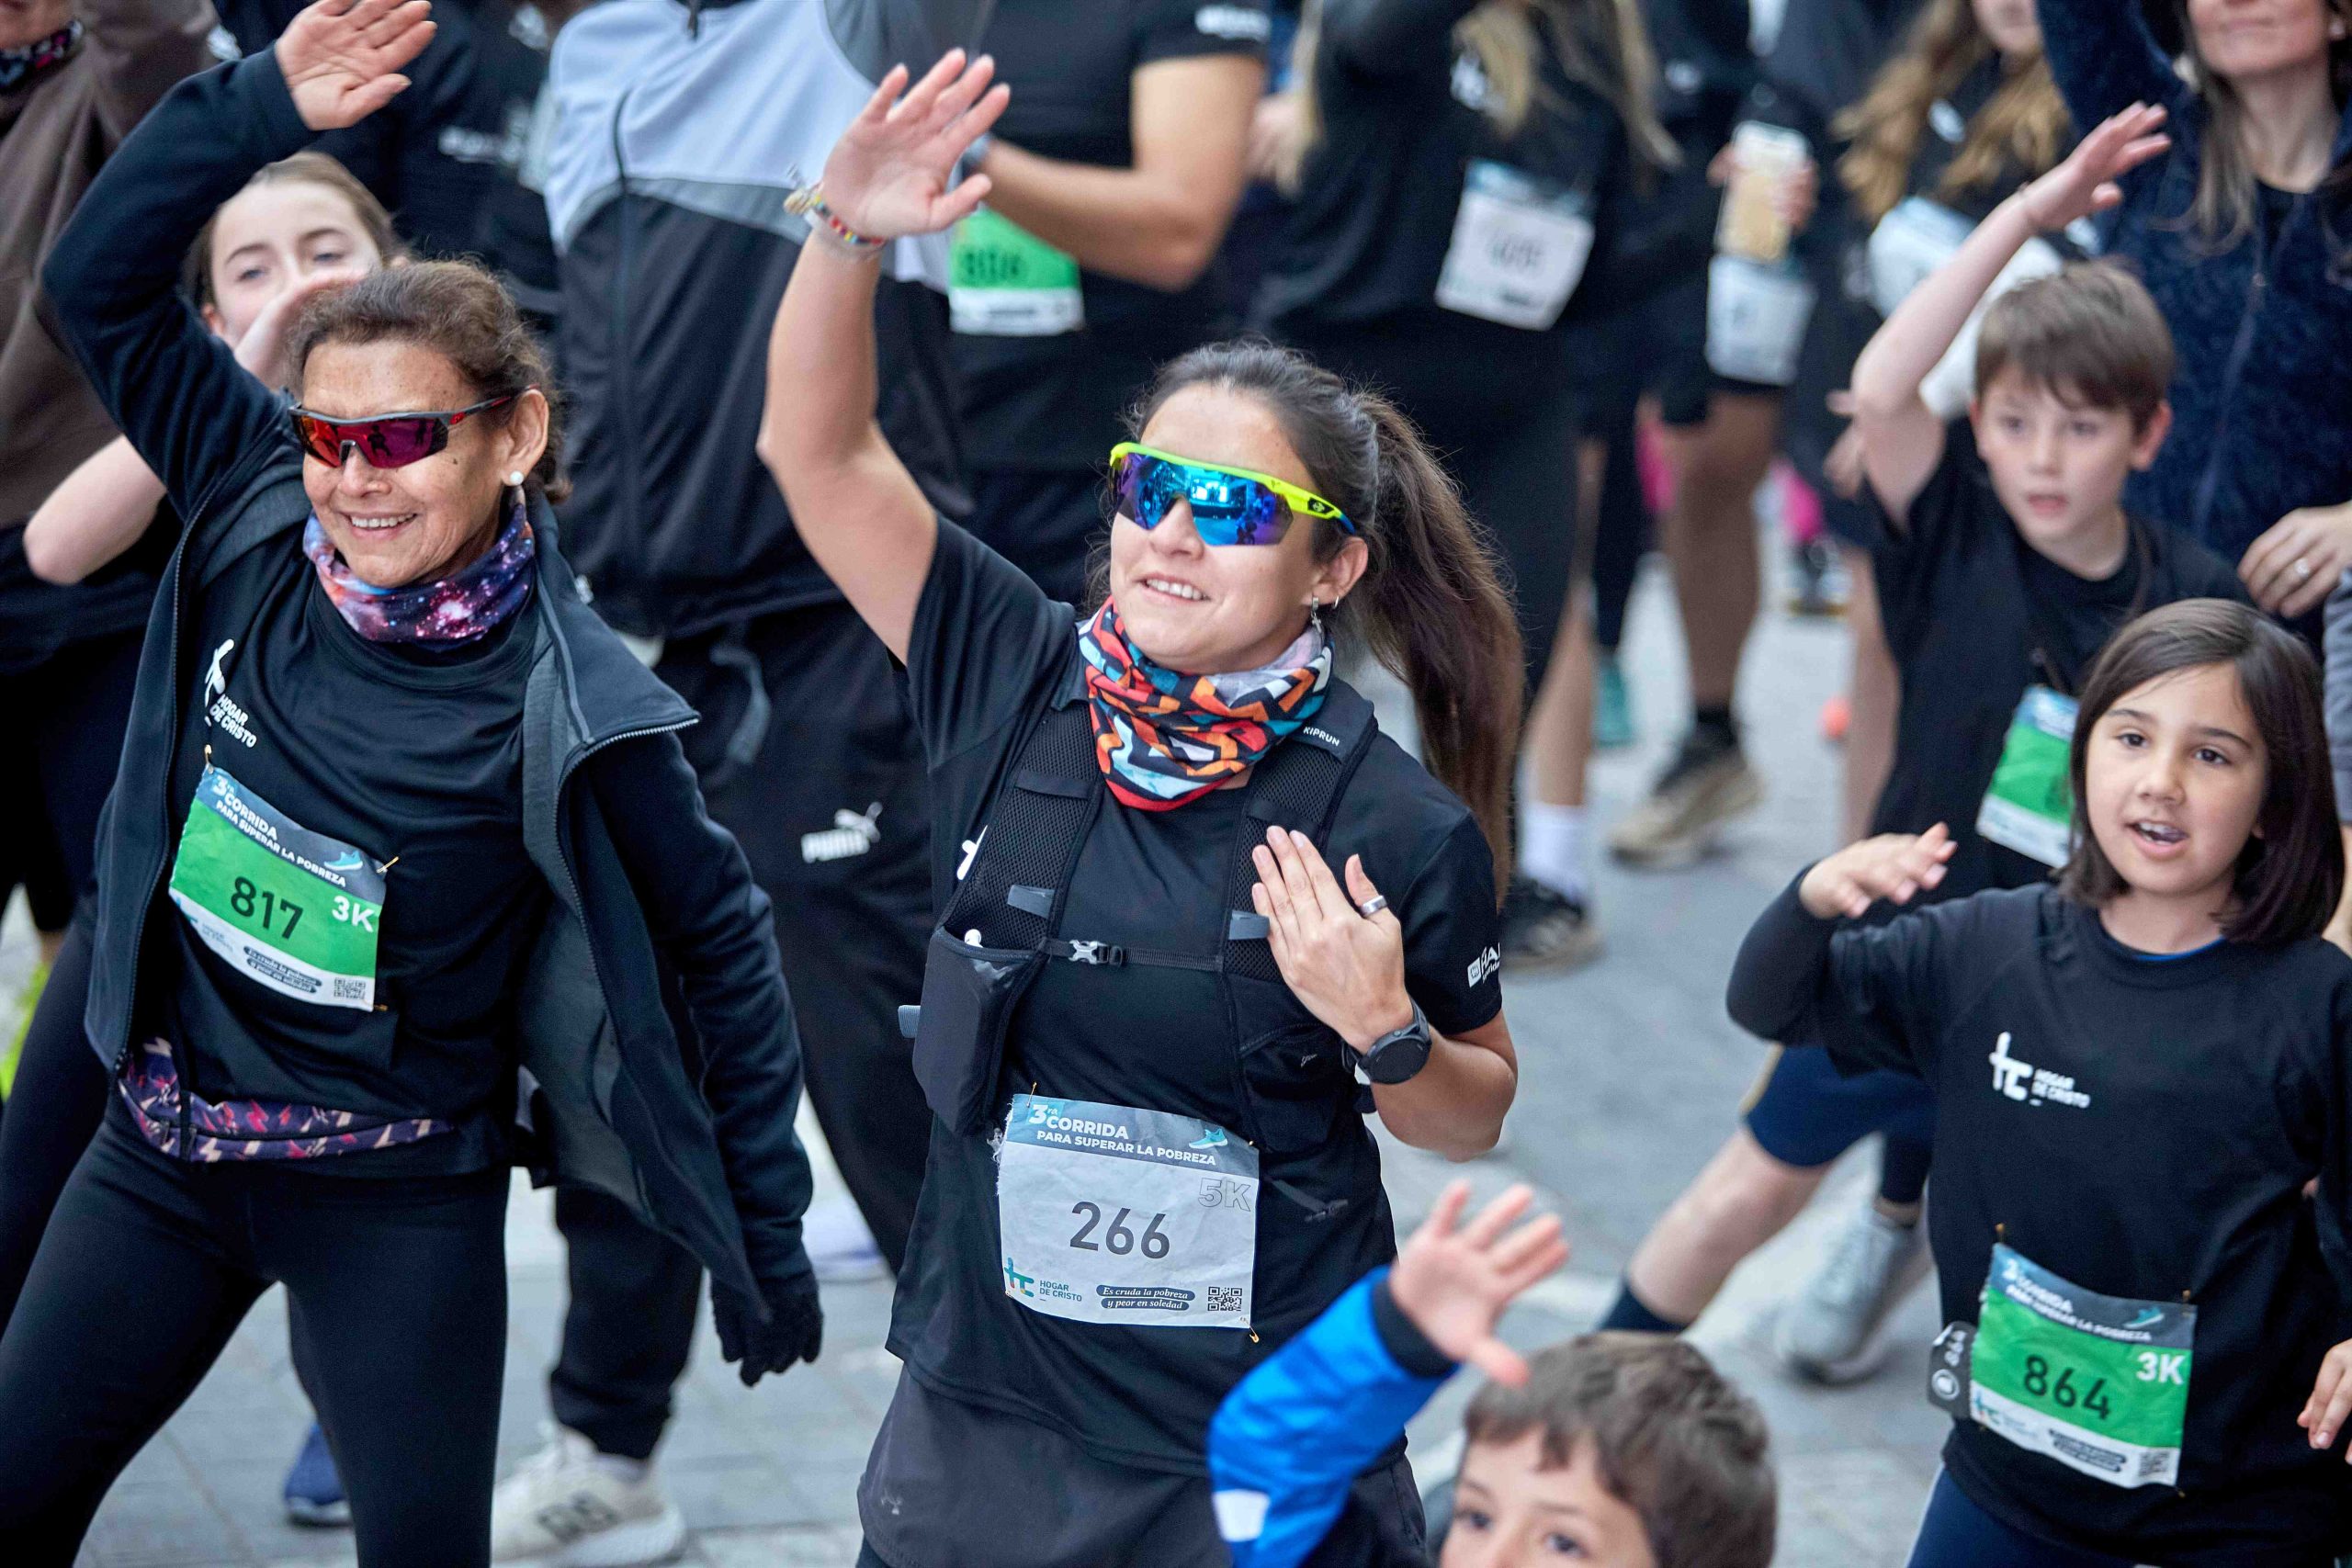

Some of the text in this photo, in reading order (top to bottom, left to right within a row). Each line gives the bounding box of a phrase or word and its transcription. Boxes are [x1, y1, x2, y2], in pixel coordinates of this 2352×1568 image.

[209, 704, 257, 748] DE CRISTO
[217, 694, 249, 727] HOGAR
[1303, 727, 1340, 747] KIPRUN
[225, 793, 277, 841] CORRIDA
[216, 800, 346, 887] PARA SUPERAR LA POBREZA
[231, 876, 303, 940] 817
[332, 896, 375, 933] 3K
[1029, 1104, 1129, 1140] 3ra CORRIDA
[1036, 1130, 1216, 1166] PARA SUPERAR LA POBREZA
[1197, 1177, 1251, 1213] 5K
[1069, 1201, 1170, 1259] 266
[1039, 1280, 1069, 1292] HOGAR
[1039, 1287, 1082, 1303] DE CRISTO
[1102, 1286, 1189, 1300] Es cruda la pobreza
[1107, 1301, 1114, 1309] y
[1114, 1300, 1136, 1308] peor
[1149, 1299, 1182, 1309] soledad
[2136, 1351, 2187, 1385] 3K
[2023, 1354, 2110, 1420] 864
